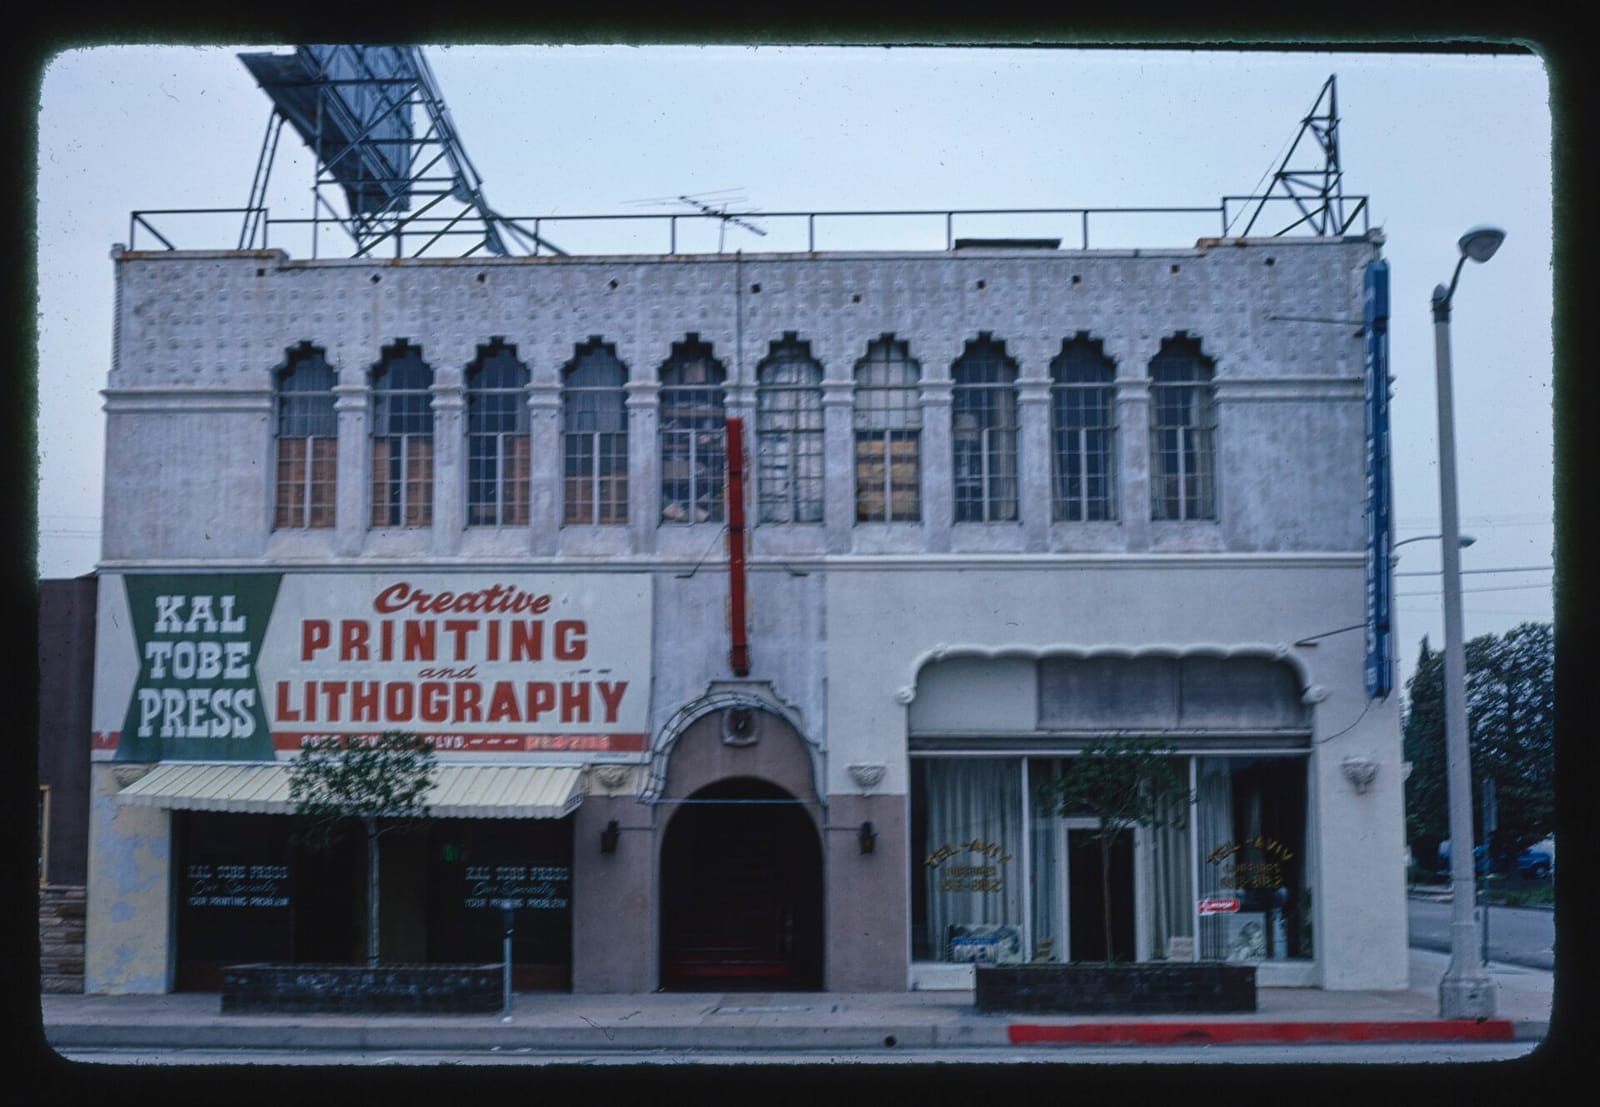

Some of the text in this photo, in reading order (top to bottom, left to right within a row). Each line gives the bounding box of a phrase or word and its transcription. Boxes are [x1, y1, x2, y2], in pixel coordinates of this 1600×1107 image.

[154, 595, 246, 633] KAL
[373, 581, 552, 614] Creative
[145, 641, 251, 680] TOBE
[301, 620, 588, 662] PRINTING
[417, 664, 478, 680] and
[137, 688, 257, 738] PRESS
[275, 680, 631, 724] LITHOGRAPHY
